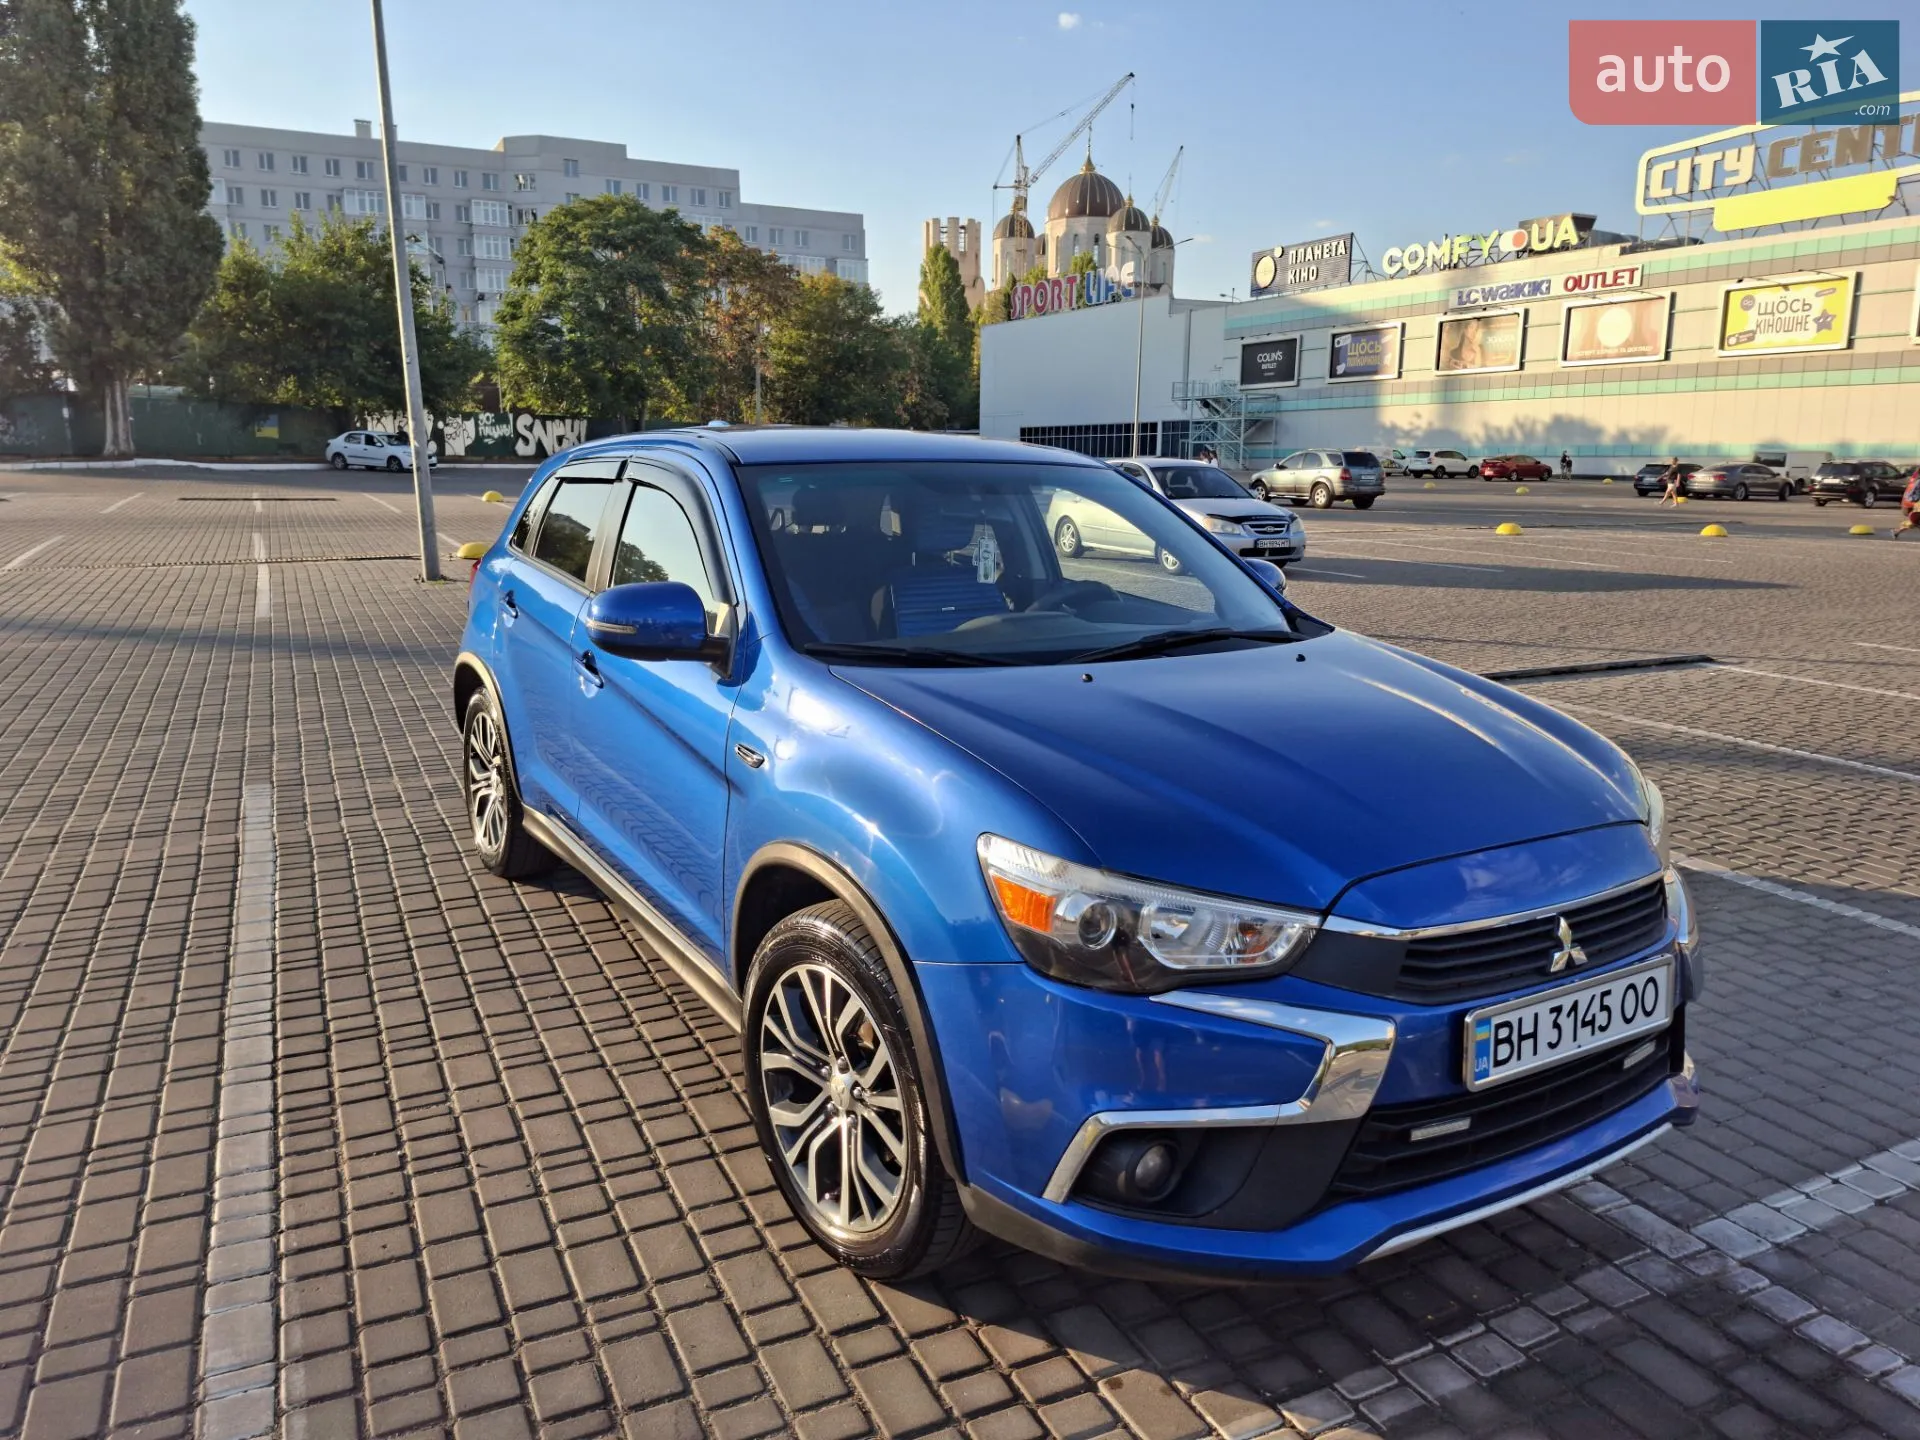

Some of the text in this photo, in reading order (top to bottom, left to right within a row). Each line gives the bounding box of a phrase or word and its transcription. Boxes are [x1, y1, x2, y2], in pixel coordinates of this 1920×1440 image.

[1649, 112, 1920, 199] CITY CENT
[1288, 240, 1346, 265] ПЛАНЕТА
[1382, 216, 1579, 275] COMFY UA
[1010, 260, 1136, 320] SPORT LIFE
[1287, 266, 1318, 284] КІНО
[1457, 288, 1479, 305] LC
[1563, 267, 1639, 292] OUTLET
[1755, 314, 1811, 335] КІНОШНЕ
[1256, 349, 1283, 363] COLIN'S
[1492, 1012, 1539, 1068] BH
[1547, 988, 1612, 1050] 3145
[1474, 1058, 1489, 1073] UA
